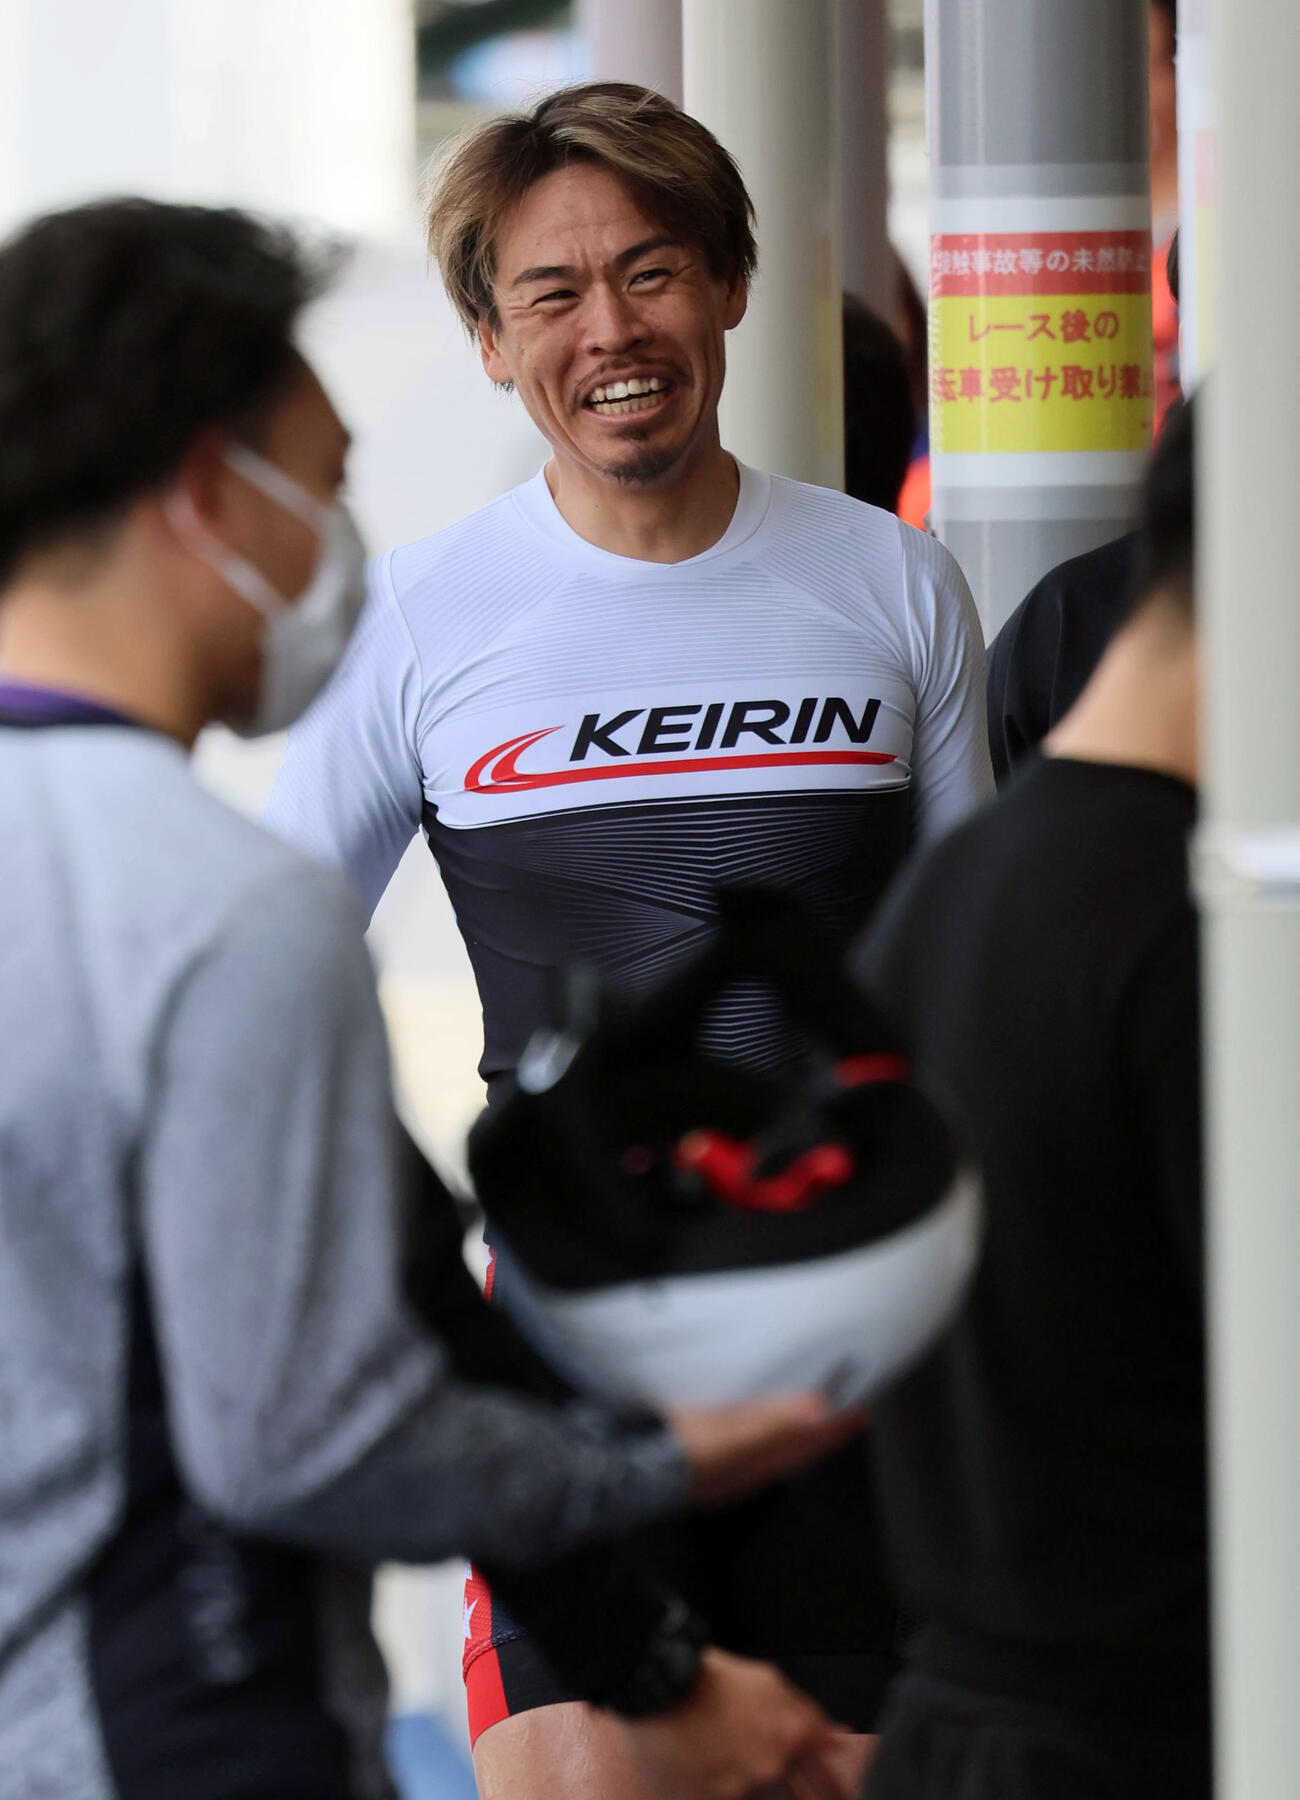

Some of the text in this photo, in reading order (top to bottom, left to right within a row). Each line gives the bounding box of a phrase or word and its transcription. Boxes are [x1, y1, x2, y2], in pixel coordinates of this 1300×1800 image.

[968, 309, 1120, 344] レース後の
[569, 697, 881, 762] KEIRIN
